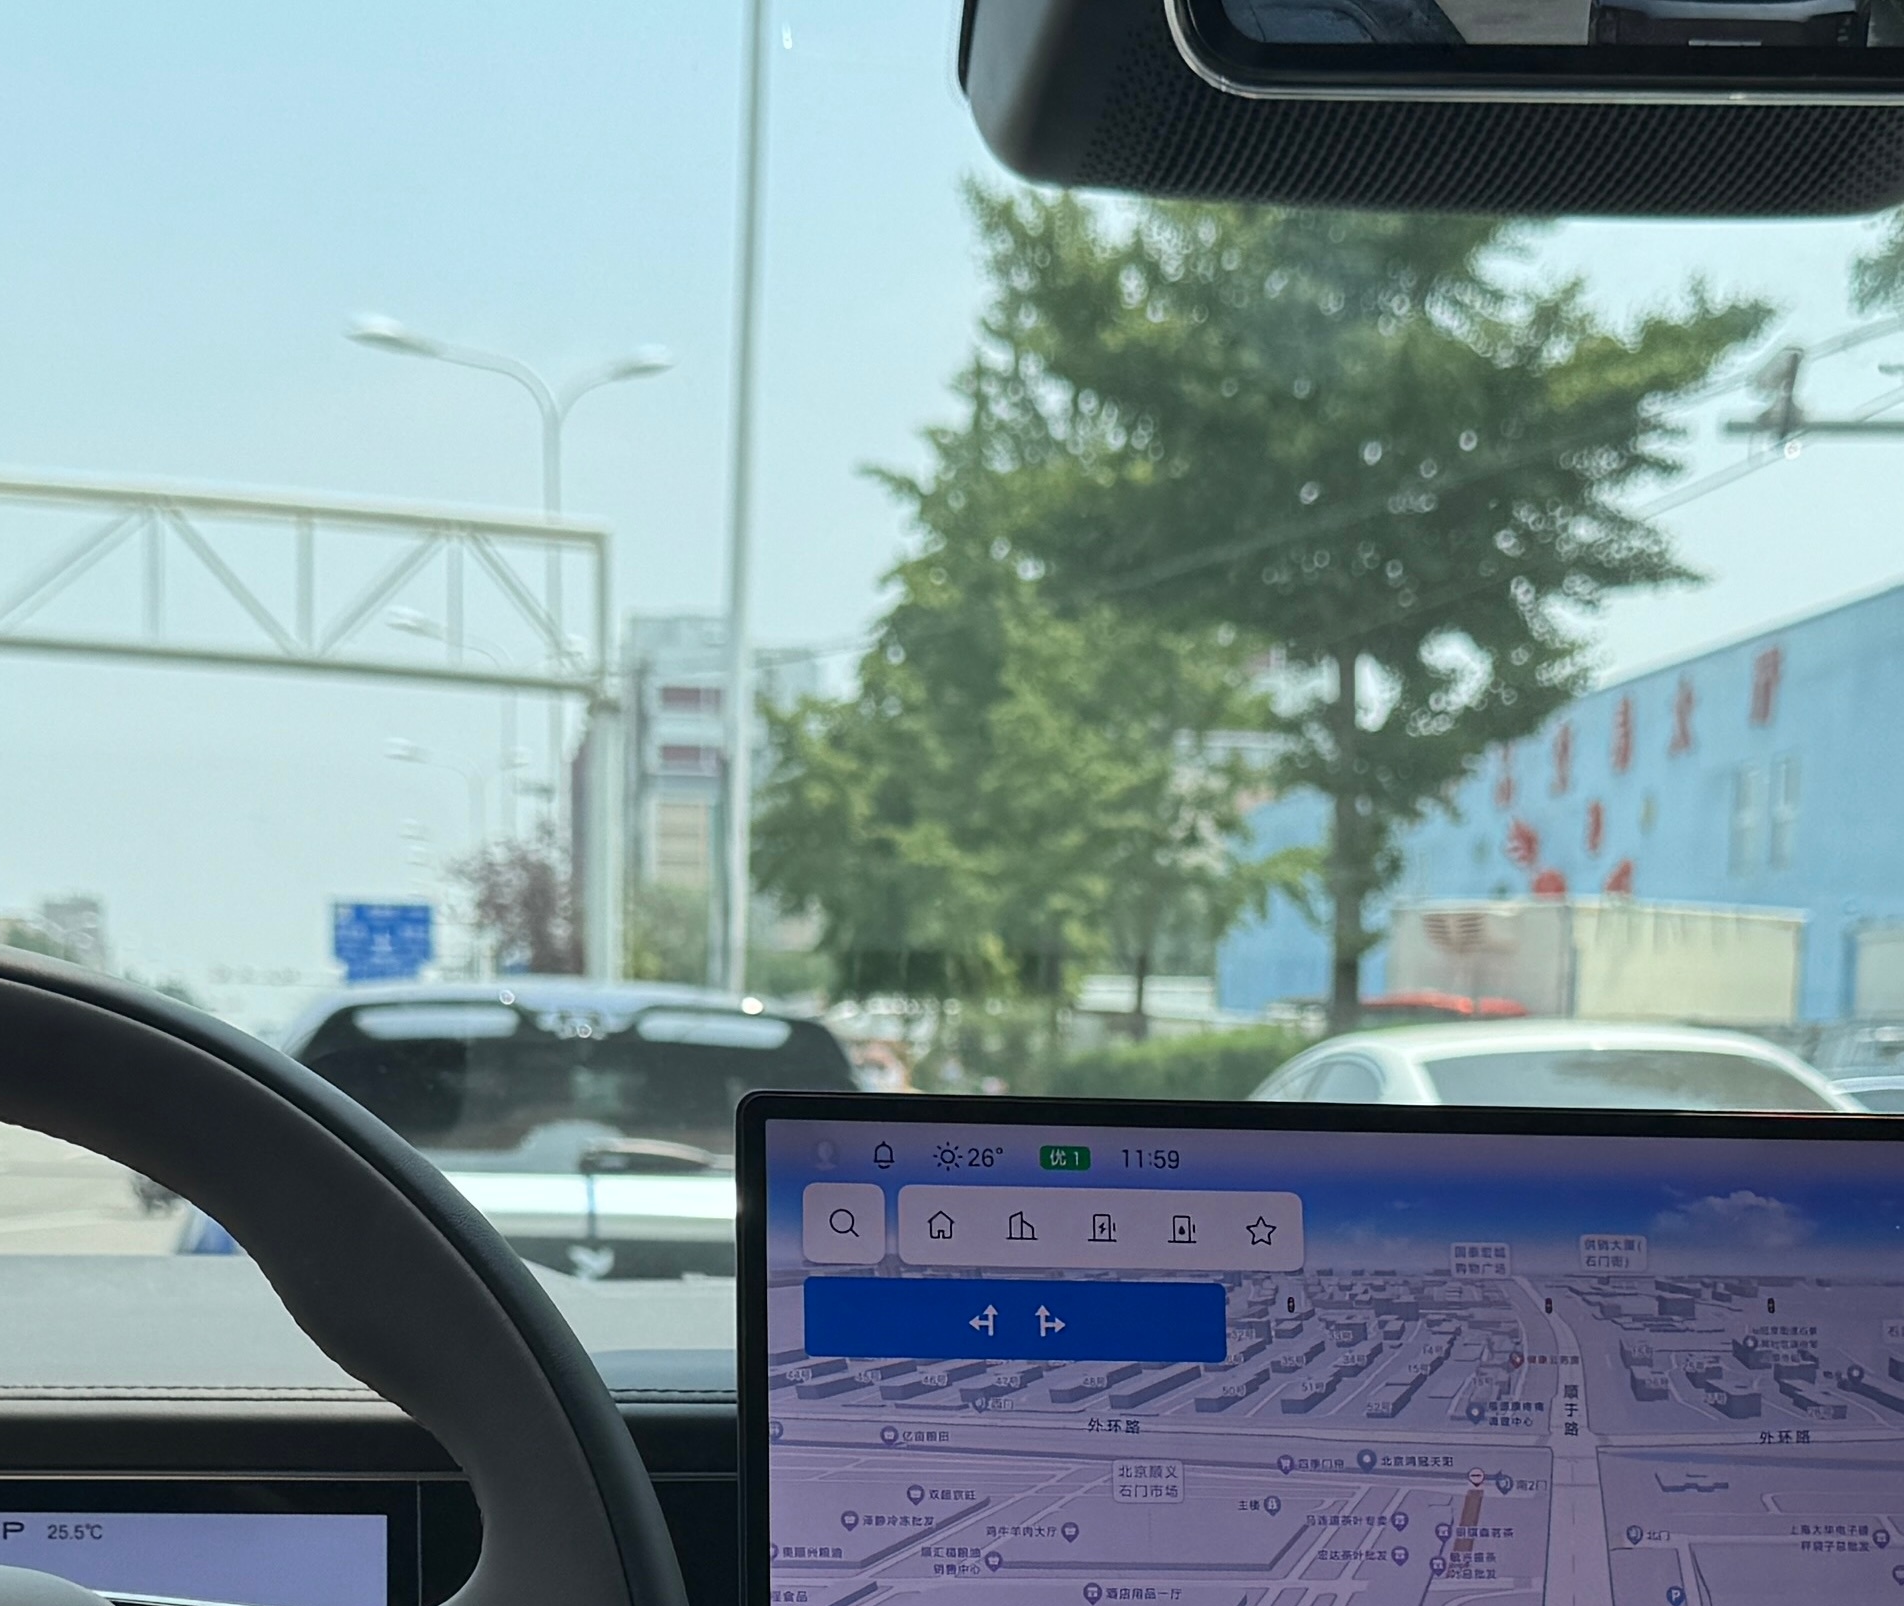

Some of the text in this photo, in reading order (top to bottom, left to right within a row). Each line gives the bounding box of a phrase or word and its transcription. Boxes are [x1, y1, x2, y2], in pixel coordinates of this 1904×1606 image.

[1073, 1151, 1081, 1166] 1
[1122, 1149, 1180, 1169] 11:59
[1087, 1418, 1141, 1435] 外环路
[1759, 1430, 1812, 1444] 外环路
[1118, 1464, 1179, 1479] 北京顺义
[1118, 1484, 1179, 1499] 石门市场
[1646, 1530, 1670, 1541] 北门
[933, 1563, 981, 1576] 销售中心
